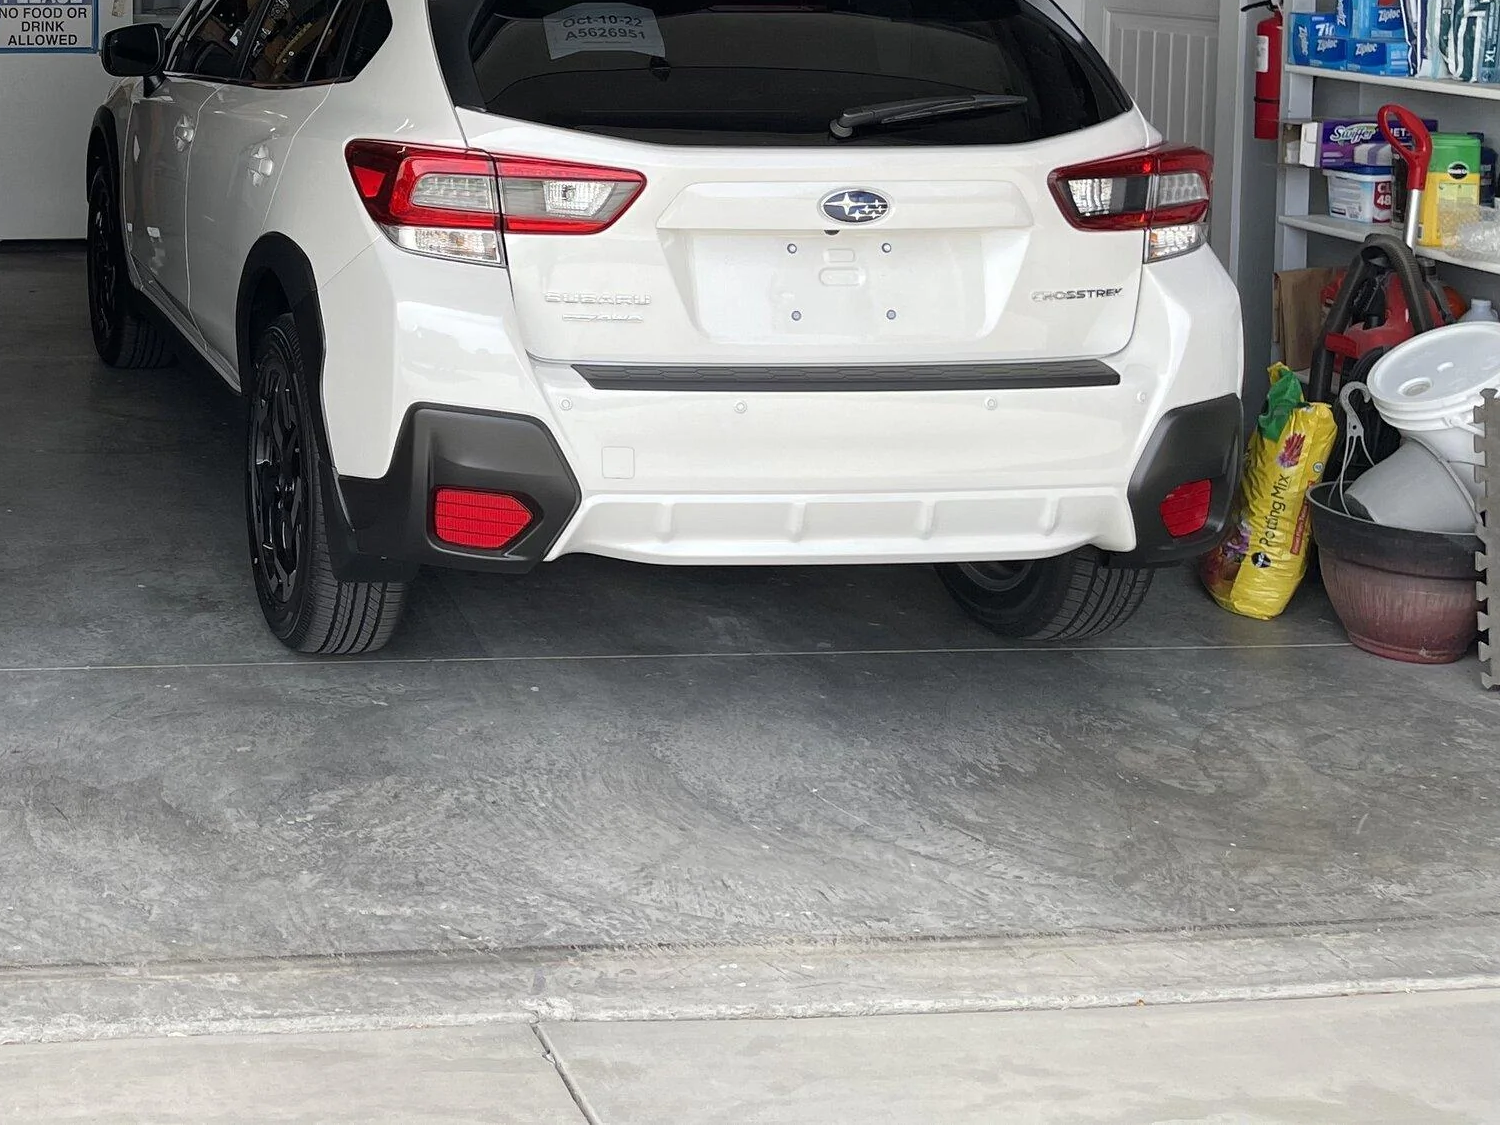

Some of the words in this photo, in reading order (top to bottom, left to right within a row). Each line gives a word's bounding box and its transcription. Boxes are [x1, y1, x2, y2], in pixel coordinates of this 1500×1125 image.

[23, 7, 63, 19] FOOD
[67, 7, 87, 19] OR
[1378, 8, 1400, 23] Ziploc
[21, 21, 64, 32] DRINK
[563, 15, 643, 28] Oct-10-22
[8, 34, 77, 46] ALLOWED
[565, 27, 645, 41] A5626951
[1317, 38, 1338, 53] Ziploc
[1355, 42, 1378, 56] Ziploc
[1484, 46, 1496, 63] XL
[1330, 124, 1377, 144] Swiffer
[1377, 195, 1391, 206] 48
[544, 291, 651, 305] SUBARU
[1031, 288, 1123, 302] CROSSTREK
[1271, 473, 1290, 499] Mix
[1259, 500, 1286, 547] Potting
